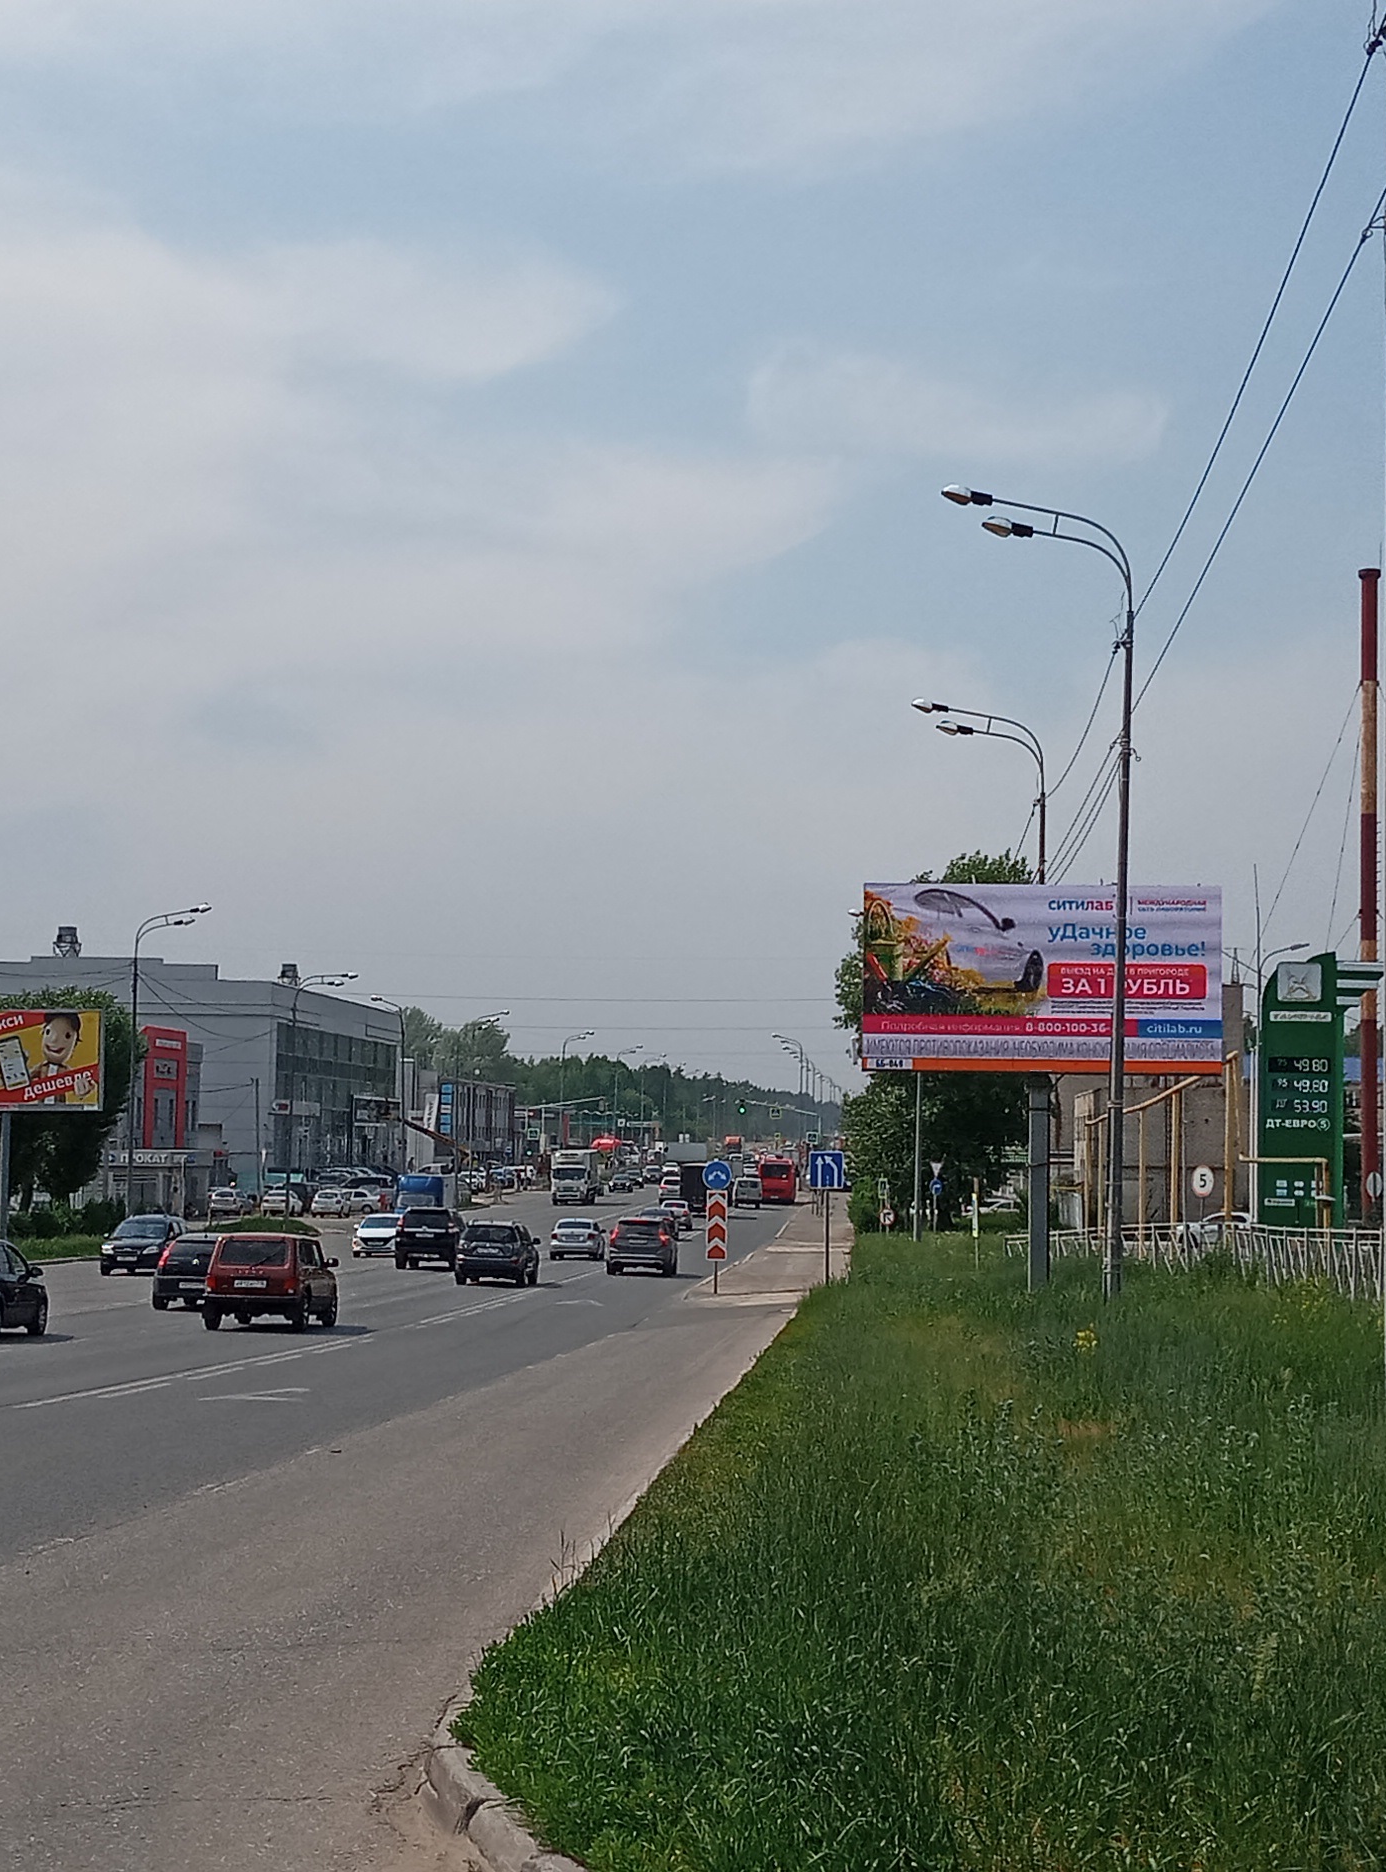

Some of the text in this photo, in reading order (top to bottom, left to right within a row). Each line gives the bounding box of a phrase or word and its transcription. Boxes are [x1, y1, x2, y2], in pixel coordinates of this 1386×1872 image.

[1048, 899, 1114, 911] ситилаб
[1090, 941, 1206, 959] здровье!
[1061, 978, 1190, 995] ЗА 1 УБЛЬ
[1025, 1022, 1112, 1034] 8-800-100-36-
[1146, 1023, 1203, 1035] citilab.ru
[1265, 1119, 1317, 1129] ДТ-ЕВРО
[1199, 1173, 1207, 1188] 5
